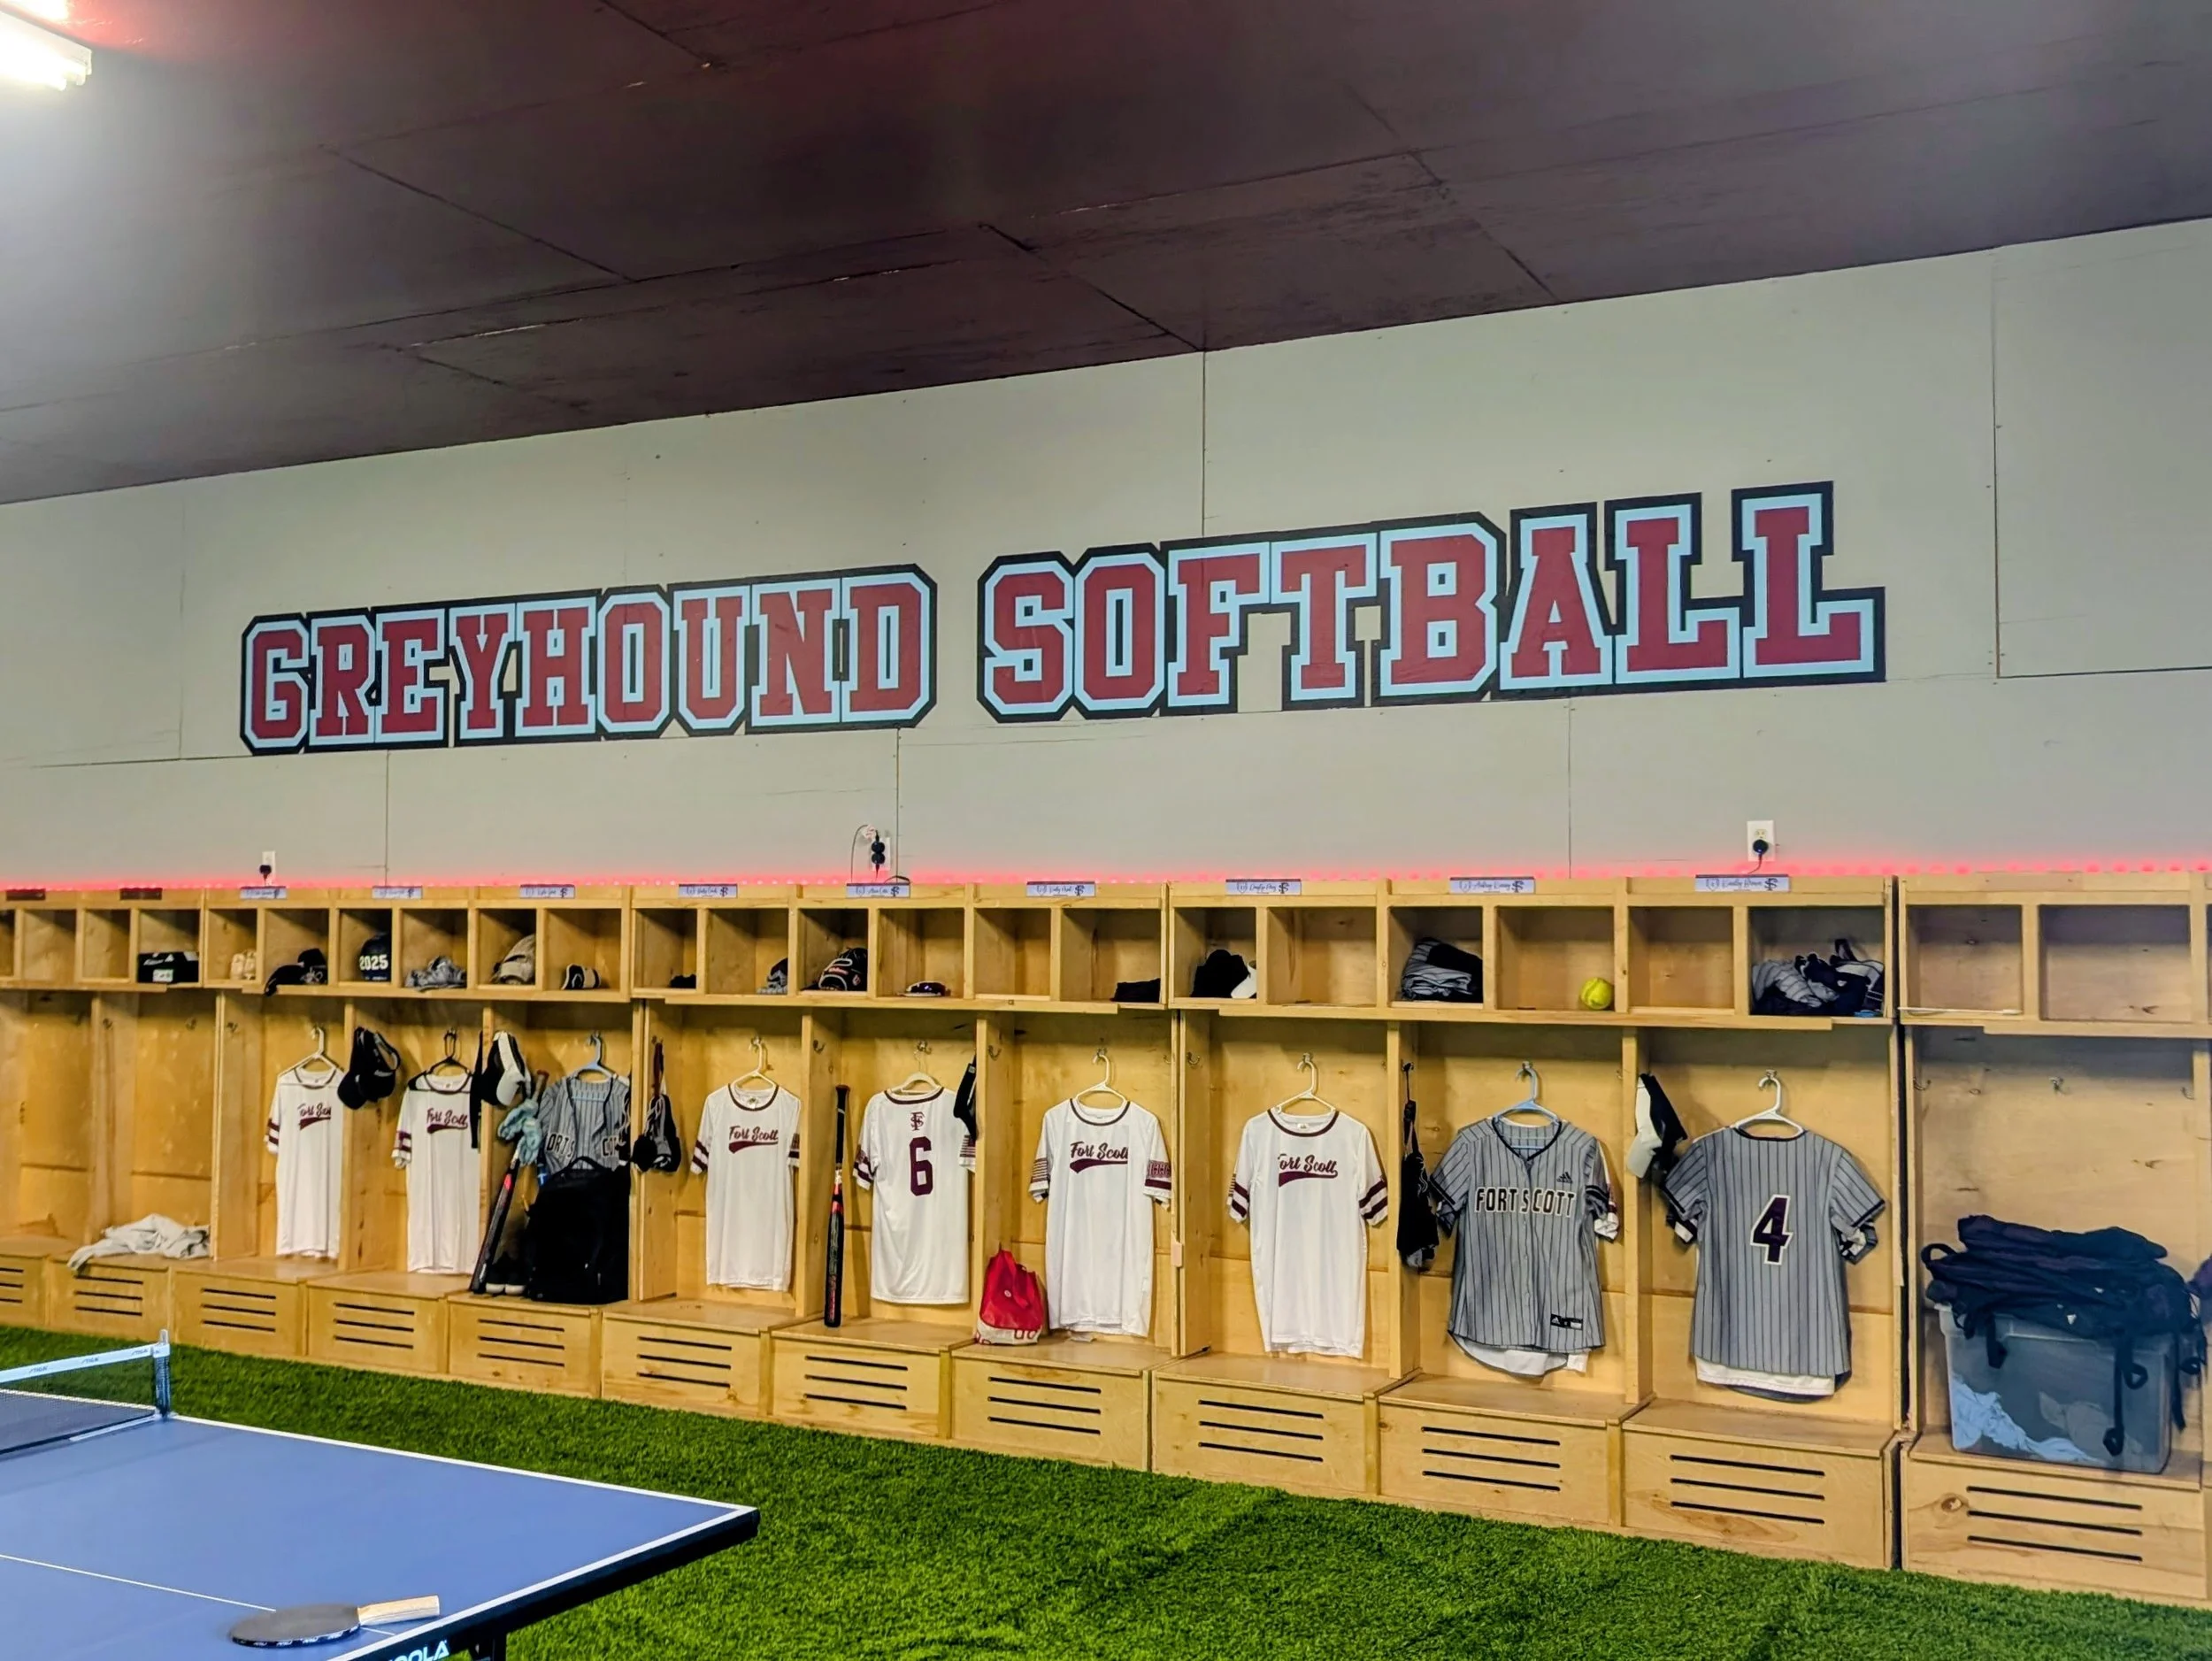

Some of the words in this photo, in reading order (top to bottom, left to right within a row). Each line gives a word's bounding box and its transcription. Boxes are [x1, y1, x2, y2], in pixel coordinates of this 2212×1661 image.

[241, 564, 938, 756] GREYHOUND
[978, 481, 1886, 723] SOFTBALL
[358, 954, 389, 971] 2025
[545, 1133, 571, 1156] ORT
[728, 1125, 749, 1141] Fort
[751, 1126, 779, 1142] Scott
[1070, 1141, 1094, 1159] Fort
[909, 1136, 933, 1196] 6
[1303, 1154, 1338, 1173] Scott
[1475, 1187, 1518, 1212] FORT
[1520, 1187, 1576, 1218] SCOTT
[1750, 1194, 1793, 1265] 4
[389, 1639, 449, 1661] OLA
